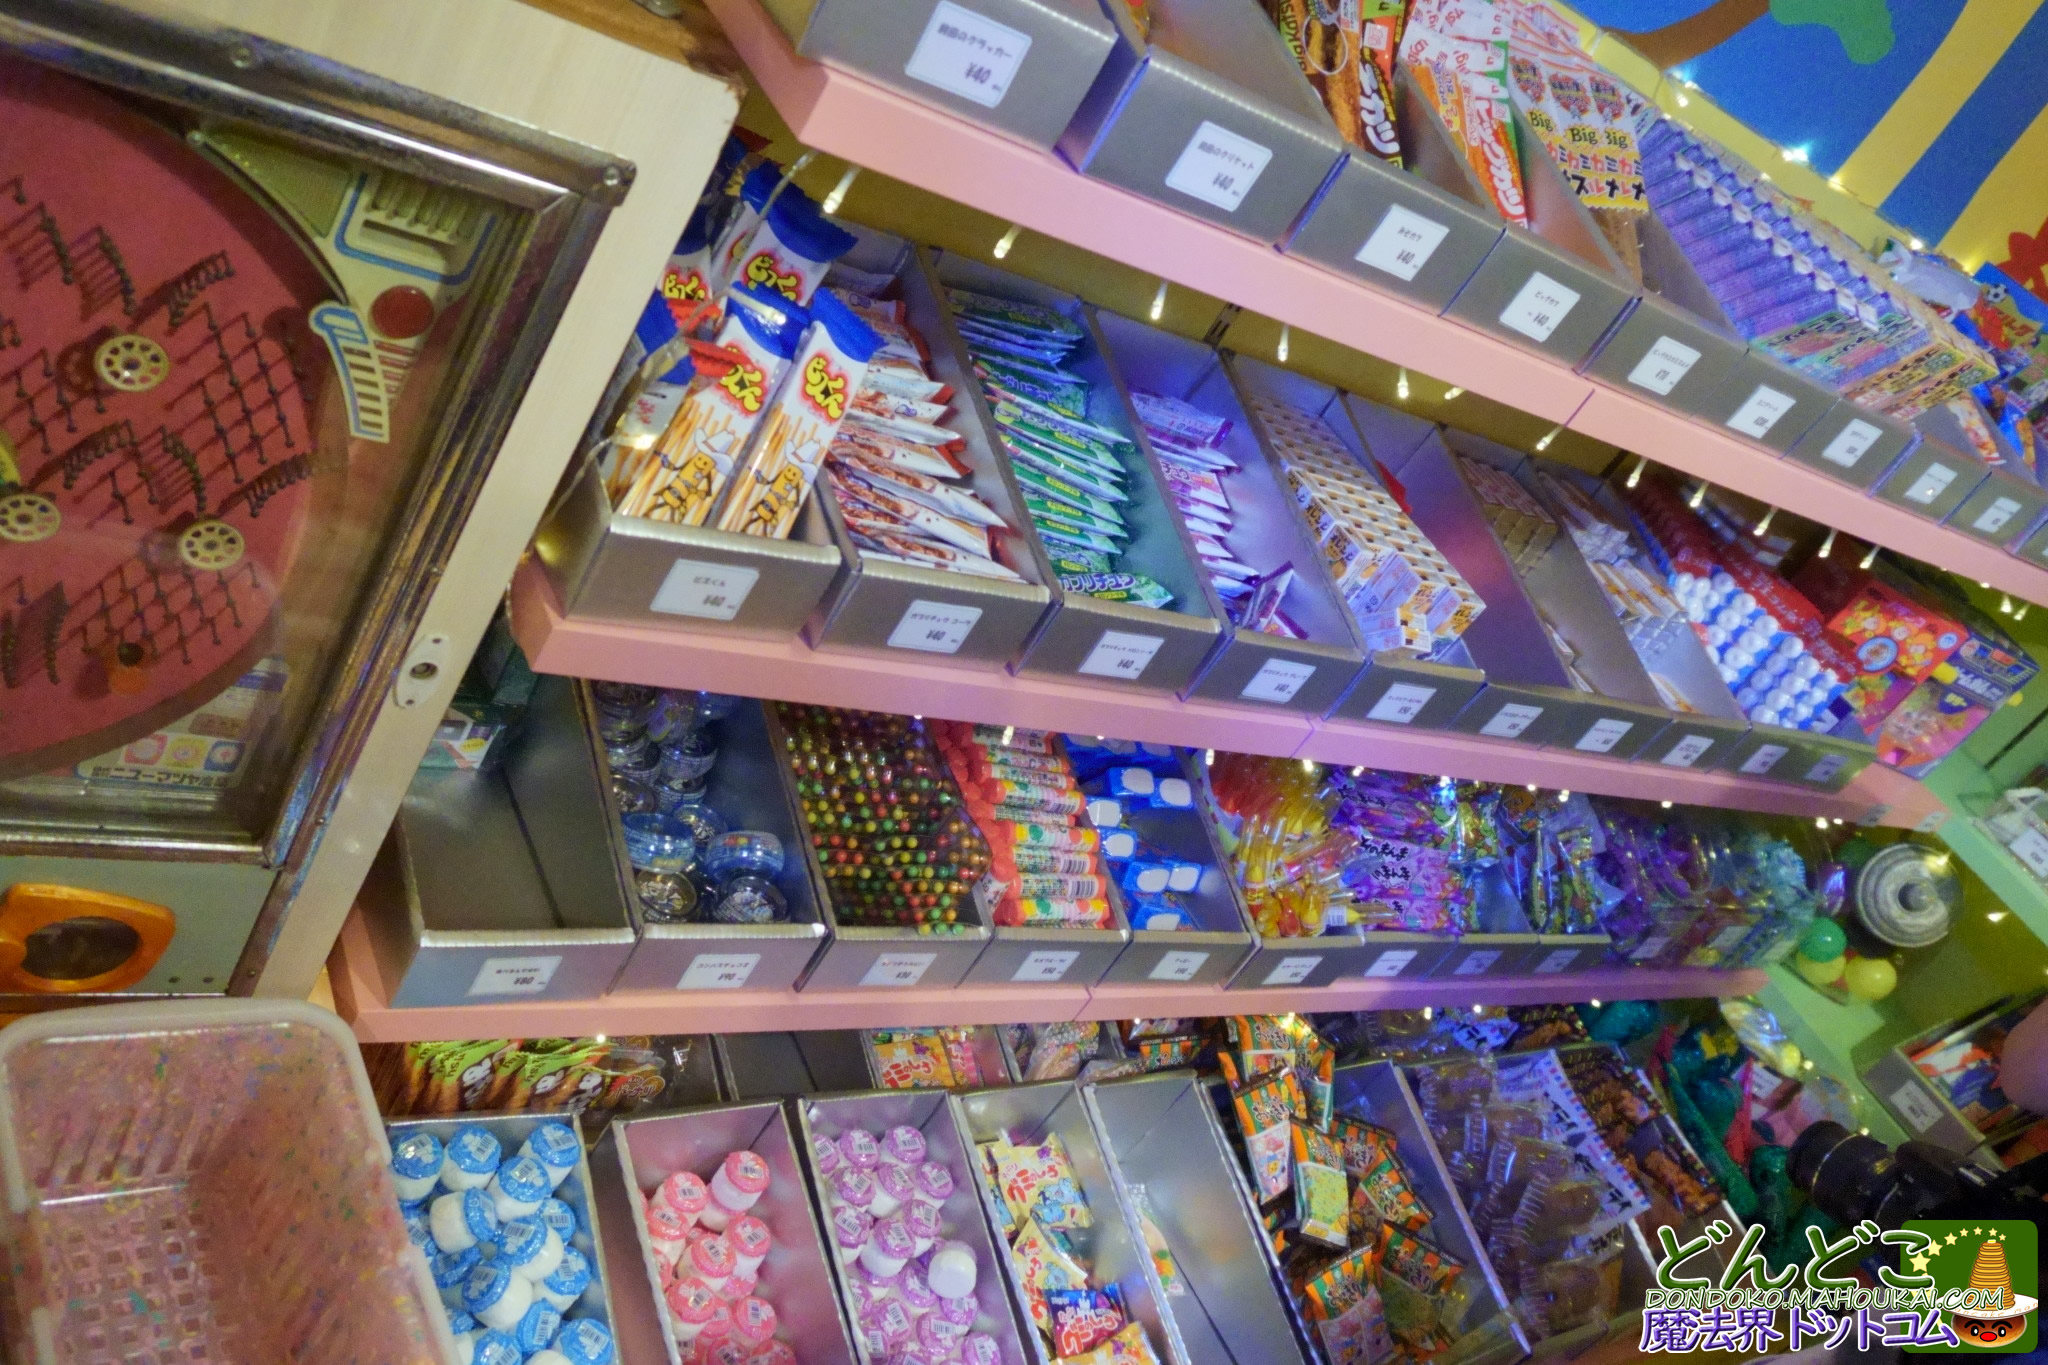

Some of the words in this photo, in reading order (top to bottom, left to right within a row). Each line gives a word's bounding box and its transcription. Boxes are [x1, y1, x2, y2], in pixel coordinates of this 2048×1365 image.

[965, 61, 992, 85] ¥40
[1528, 110, 1554, 132] Big
[1569, 126, 1599, 145] Big
[1212, 172, 1235, 191] ¥40
[1396, 249, 1416, 265] ¥40
[1532, 312, 1550, 326] ¥40
[702, 594, 727, 607] ¥40
[925, 629, 946, 641] ¥40
[1116, 658, 1135, 669] ¥40
